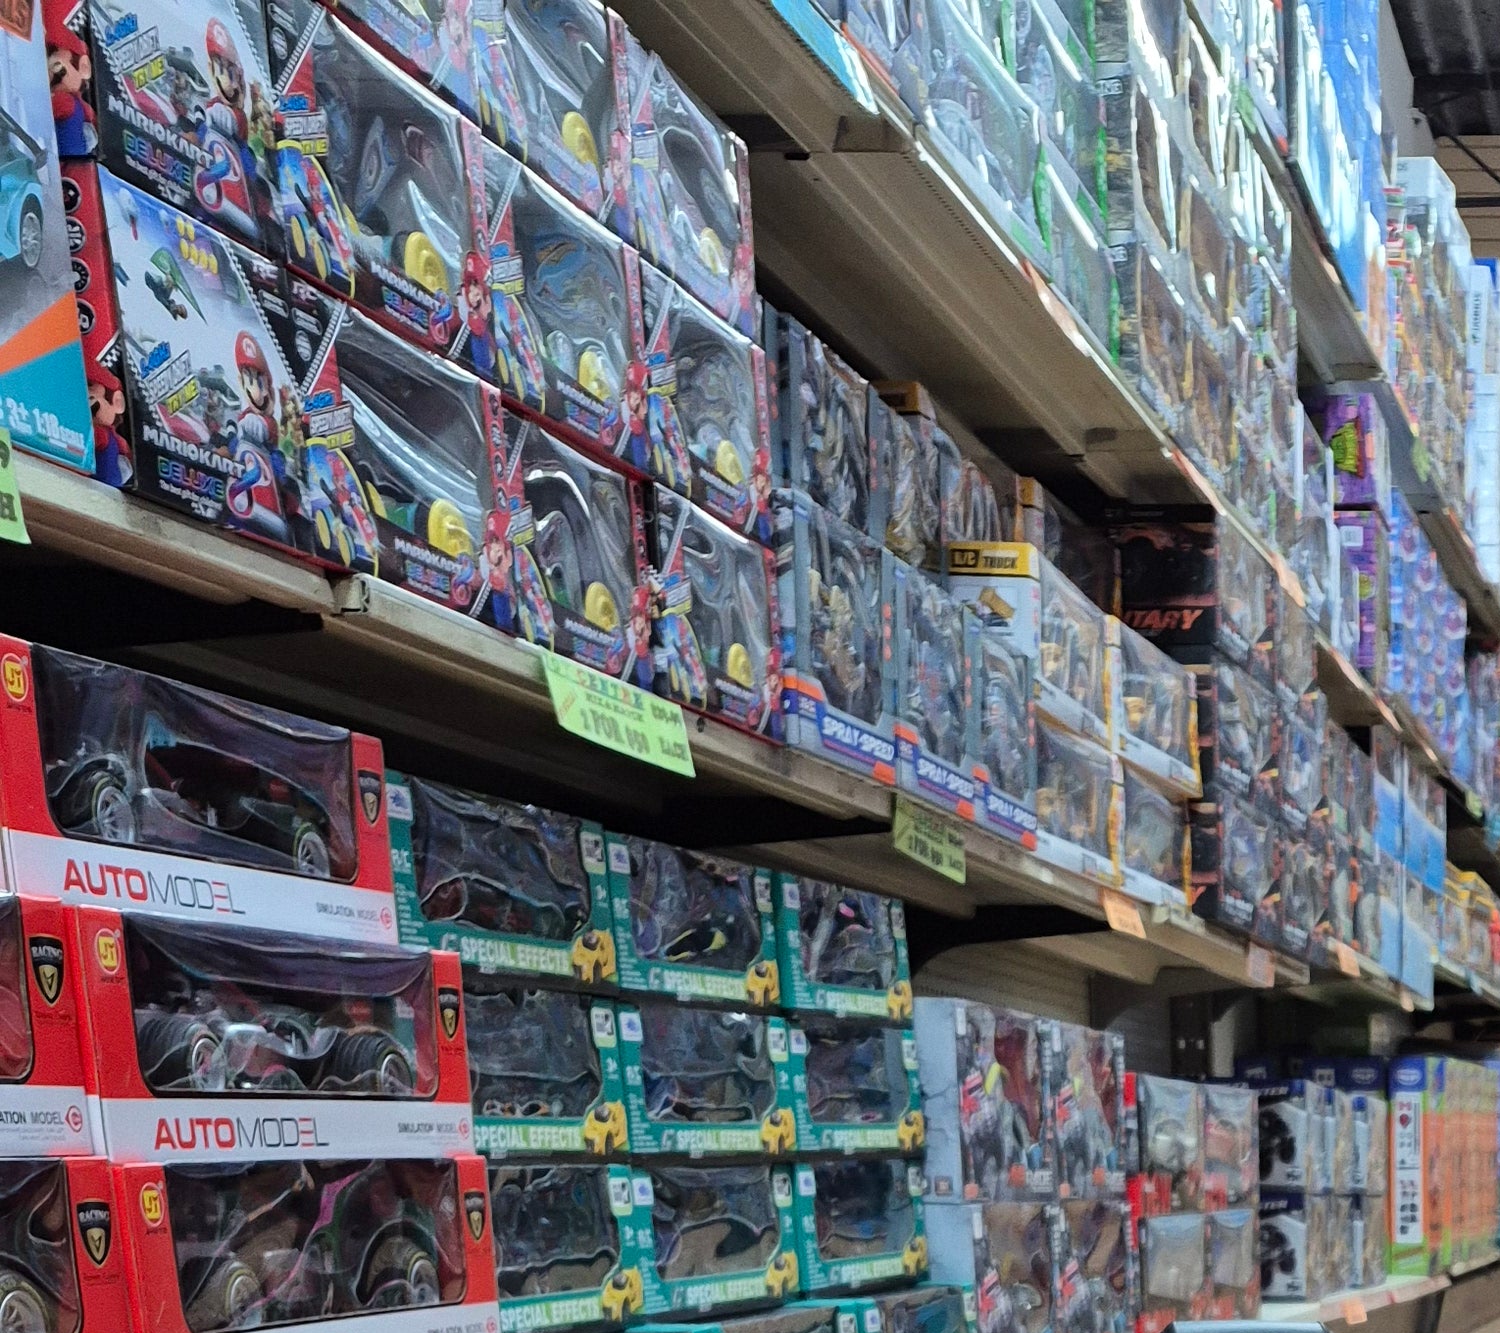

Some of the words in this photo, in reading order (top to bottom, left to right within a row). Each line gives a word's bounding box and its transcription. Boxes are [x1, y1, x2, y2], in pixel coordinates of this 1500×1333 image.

[157, 455, 225, 500] DELUXE
[31, 945, 64, 962] RACING
[461, 936, 515, 967] SPECIAL
[517, 943, 570, 974] EFFECTS
[31, 1111, 64, 1126] MODEL
[475, 1126, 527, 1150] SPECIAL
[529, 1126, 582, 1150] EFFECTS
[78, 1210, 111, 1224] RACING
[687, 1284, 727, 1305] SPECIAL
[500, 1303, 549, 1333] SPECIAL
[551, 1298, 601, 1326] EFFECTS
